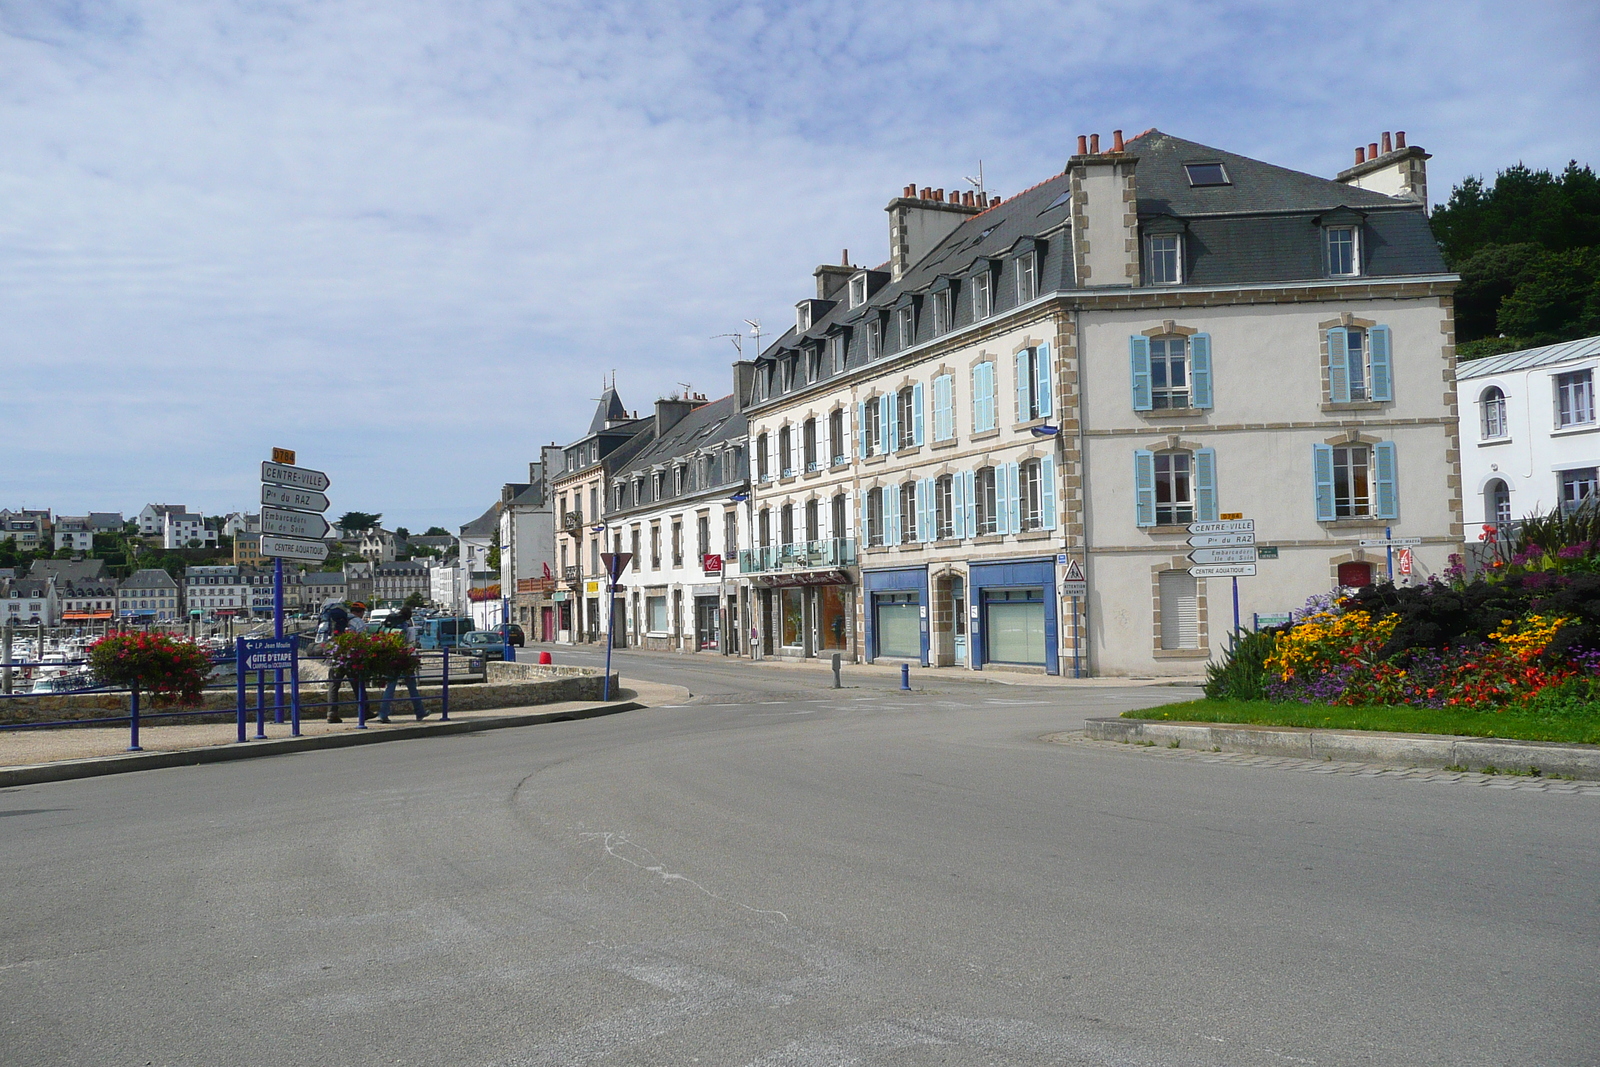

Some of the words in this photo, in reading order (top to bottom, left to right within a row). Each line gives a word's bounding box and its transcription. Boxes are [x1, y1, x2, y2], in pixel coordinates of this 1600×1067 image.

[274, 449, 295, 463] D784
[266, 467, 322, 487] CENTRE-VILLE
[280, 492, 290, 503] du
[294, 494, 310, 505] RAZ
[1195, 522, 1252, 532] CENTRE-VILLE
[1236, 535, 1252, 543] RAZ
[274, 543, 295, 553] CENTRE
[295, 545, 324, 556] AQUATIQUE
